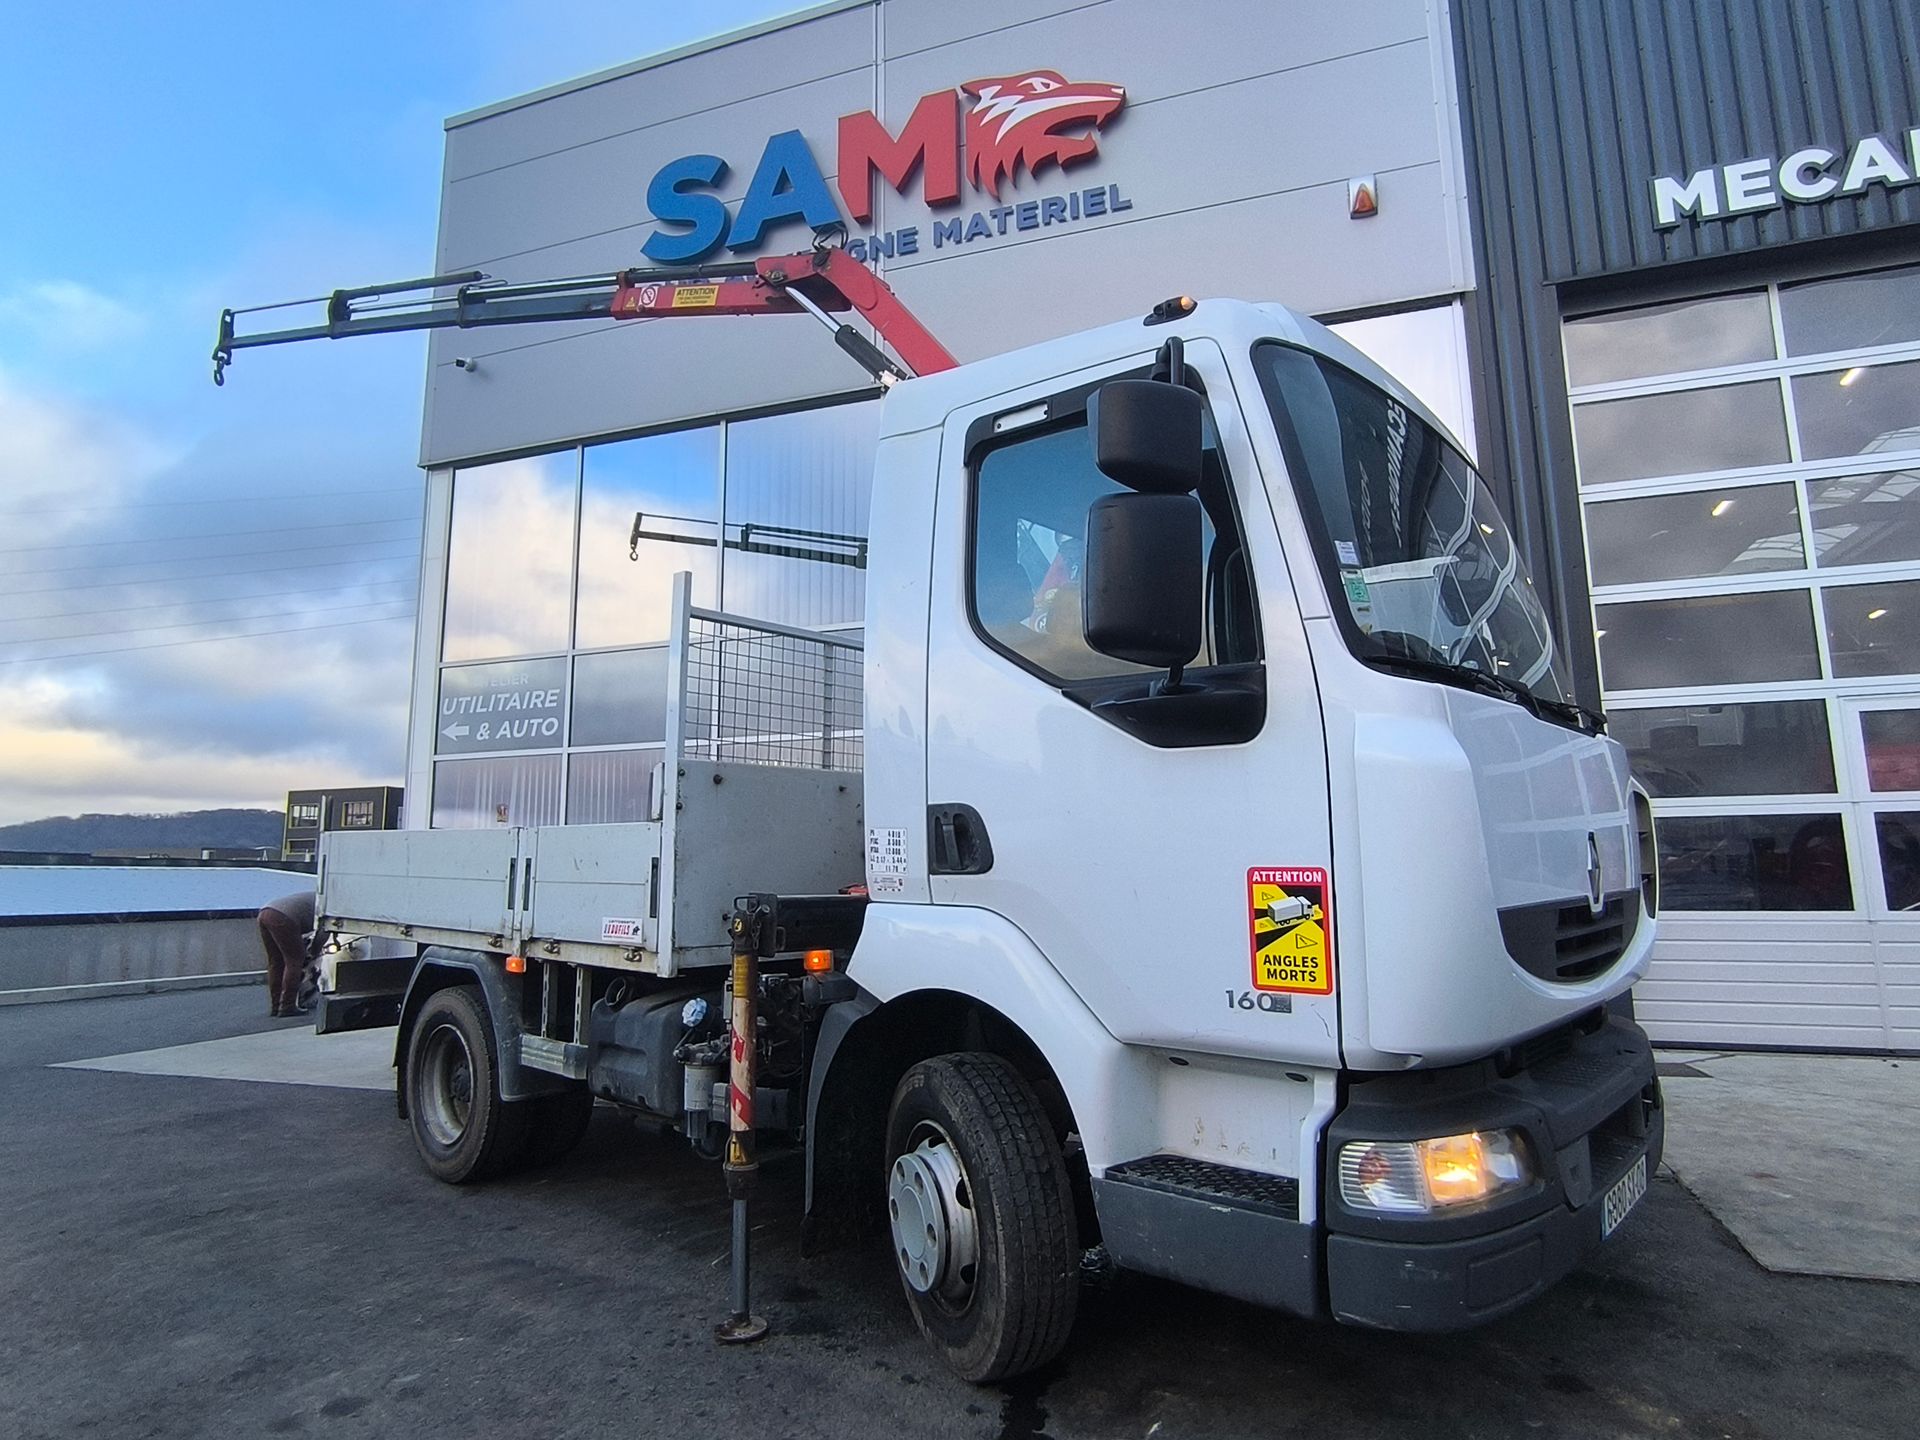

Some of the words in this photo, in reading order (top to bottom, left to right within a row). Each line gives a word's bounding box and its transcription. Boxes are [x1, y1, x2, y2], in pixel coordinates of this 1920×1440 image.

[640, 89, 962, 265] SAM
[1653, 129, 1920, 226] MECA
[932, 183, 1133, 249] MATERIEL
[677, 287, 716, 297] ATTENTION
[442, 688, 560, 715] UTILITAIRE
[476, 722, 490, 740] &
[496, 718, 559, 739] AUTO
[1252, 871, 1322, 882] ATTENTION
[1263, 954, 1319, 968] ANGLES
[1266, 968, 1317, 982] MORTS
[1225, 989, 1273, 1011] 160
